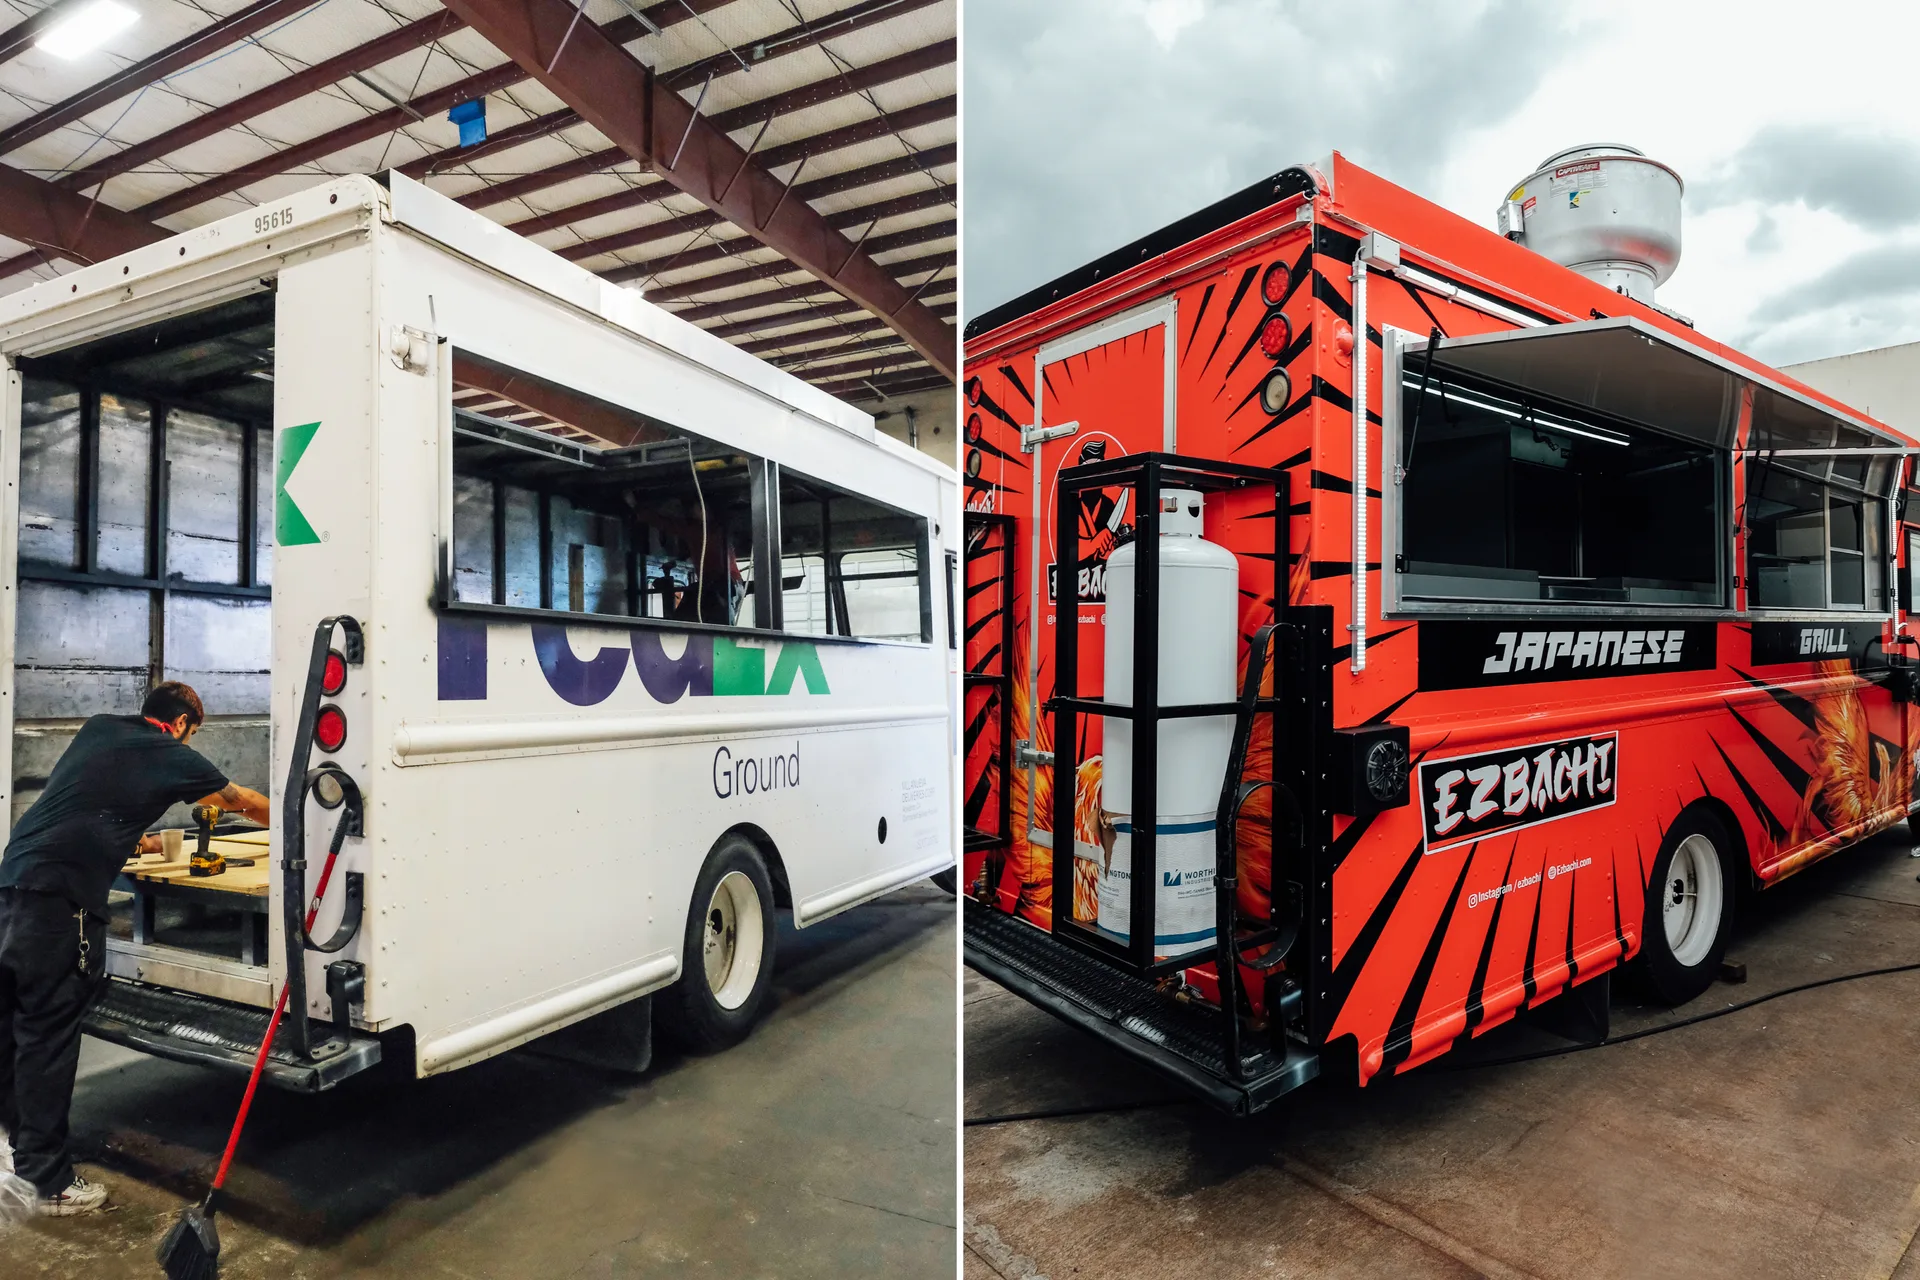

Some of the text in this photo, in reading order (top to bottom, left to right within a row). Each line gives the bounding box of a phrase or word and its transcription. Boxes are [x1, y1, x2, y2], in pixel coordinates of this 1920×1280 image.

[254, 206, 293, 234] 95615
[1483, 630, 1685, 674] JAPANESE
[1800, 628, 1848, 654] GRILL
[713, 741, 800, 799] Ground
[1433, 741, 1614, 835] EZBACHI
[1109, 869, 1131, 880] NGTON
[1184, 868, 1216, 880] WORTHI
[1556, 857, 1592, 876] Ezbachi.com
[1478, 883, 1512, 902] Instagram
